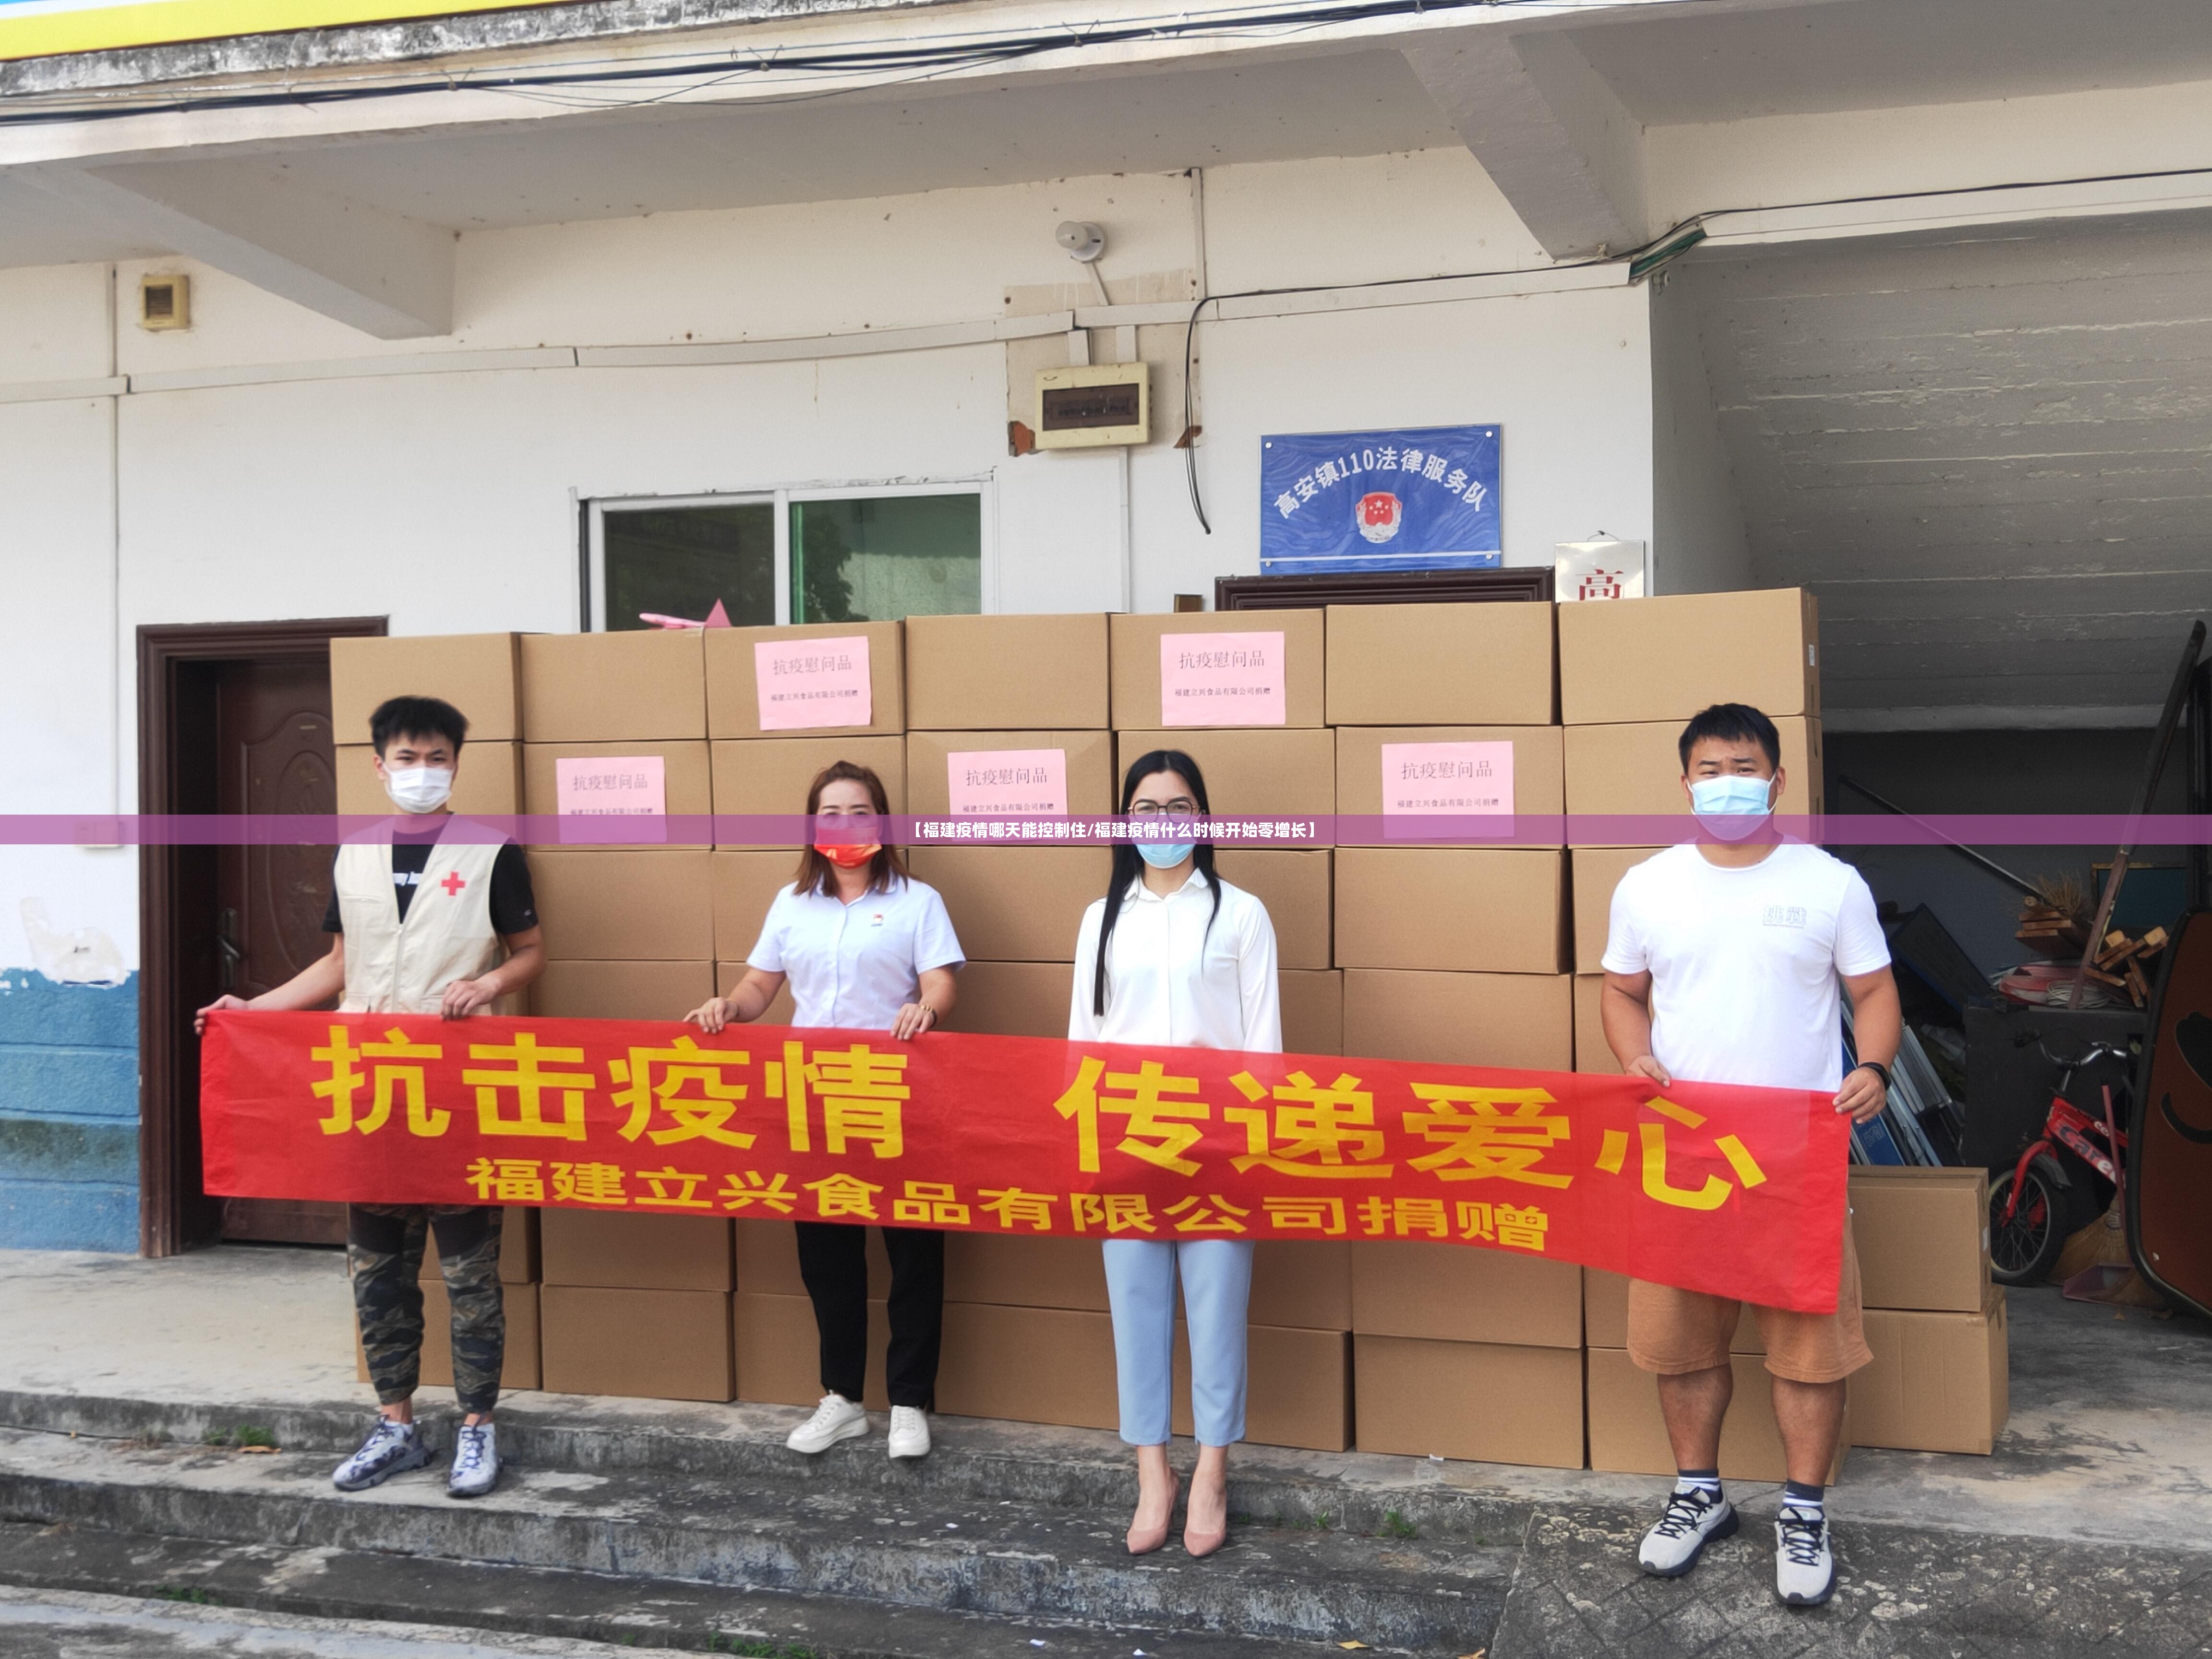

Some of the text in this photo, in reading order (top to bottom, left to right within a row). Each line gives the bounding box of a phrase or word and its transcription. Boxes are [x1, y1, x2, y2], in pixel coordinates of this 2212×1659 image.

[1274, 446, 1488, 518] 高安镇110法律服务队
[772, 654, 852, 675] 抗疫慰问品
[1178, 650, 1265, 669] 抗疫慰问品
[1174, 687, 1271, 697] 福建立兴食品有限公司捐赠
[965, 767, 1047, 786] 抗疫慰问品
[1401, 760, 1492, 780] 抗疫慰问品
[573, 773, 648, 791] 抗疫慰问品
[962, 803, 1054, 813] 福建立兴食品有限公司捐赠
[1397, 798, 1499, 808] 福建立兴食品有限公司捐赠
[311, 1024, 1767, 1211] 抗击疫情 传递爱心
[465, 1157, 1549, 1252] 福建立兴食品有限公司捐赠
